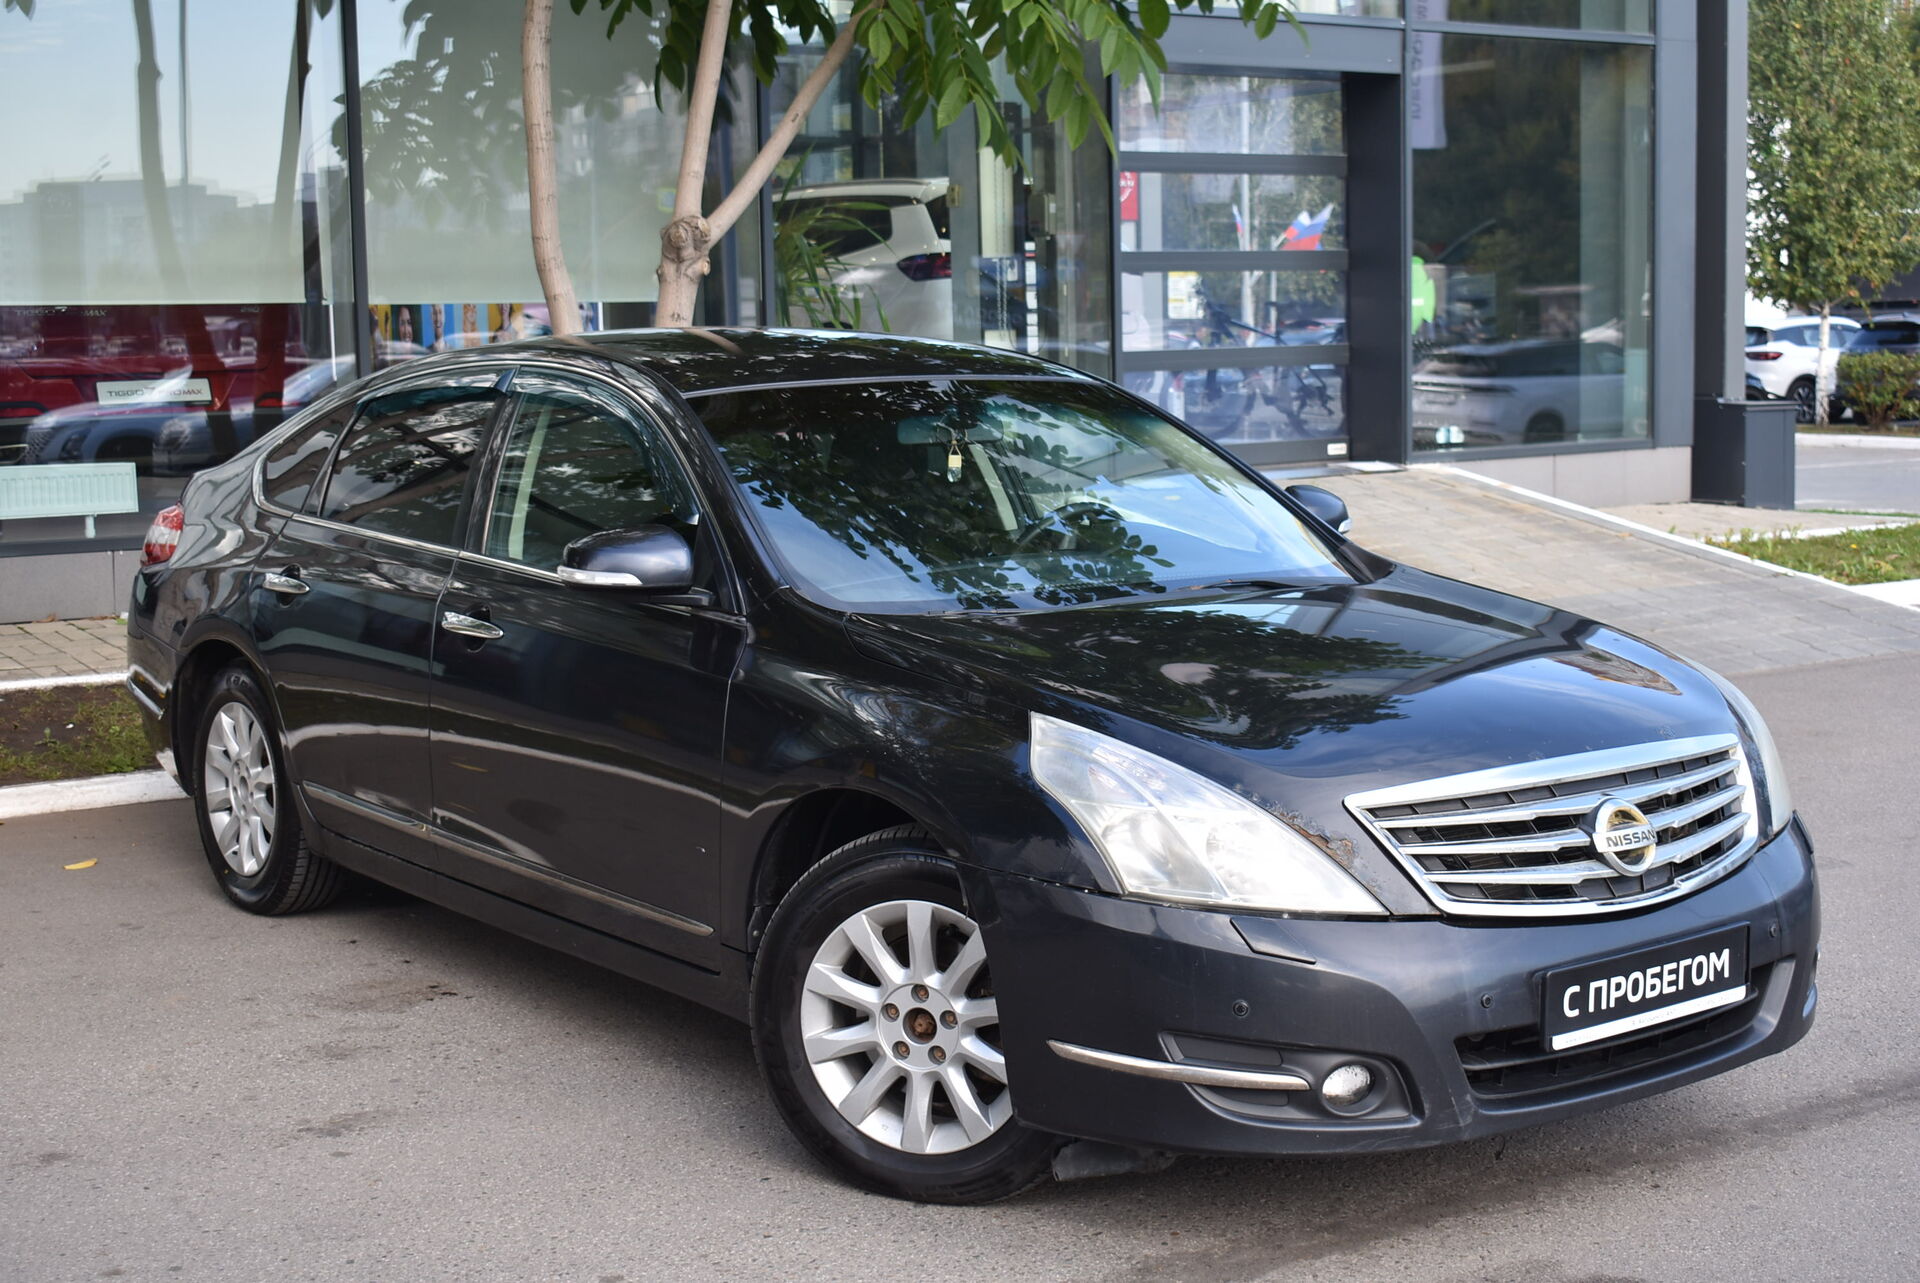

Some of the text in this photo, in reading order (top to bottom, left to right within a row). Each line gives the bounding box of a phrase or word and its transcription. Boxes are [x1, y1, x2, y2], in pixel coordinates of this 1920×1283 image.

[106, 389, 145, 397] TIGGO
[1605, 829, 1656, 847] NISSAN
[1563, 948, 1730, 1018] С ПРОБЕГОМ
